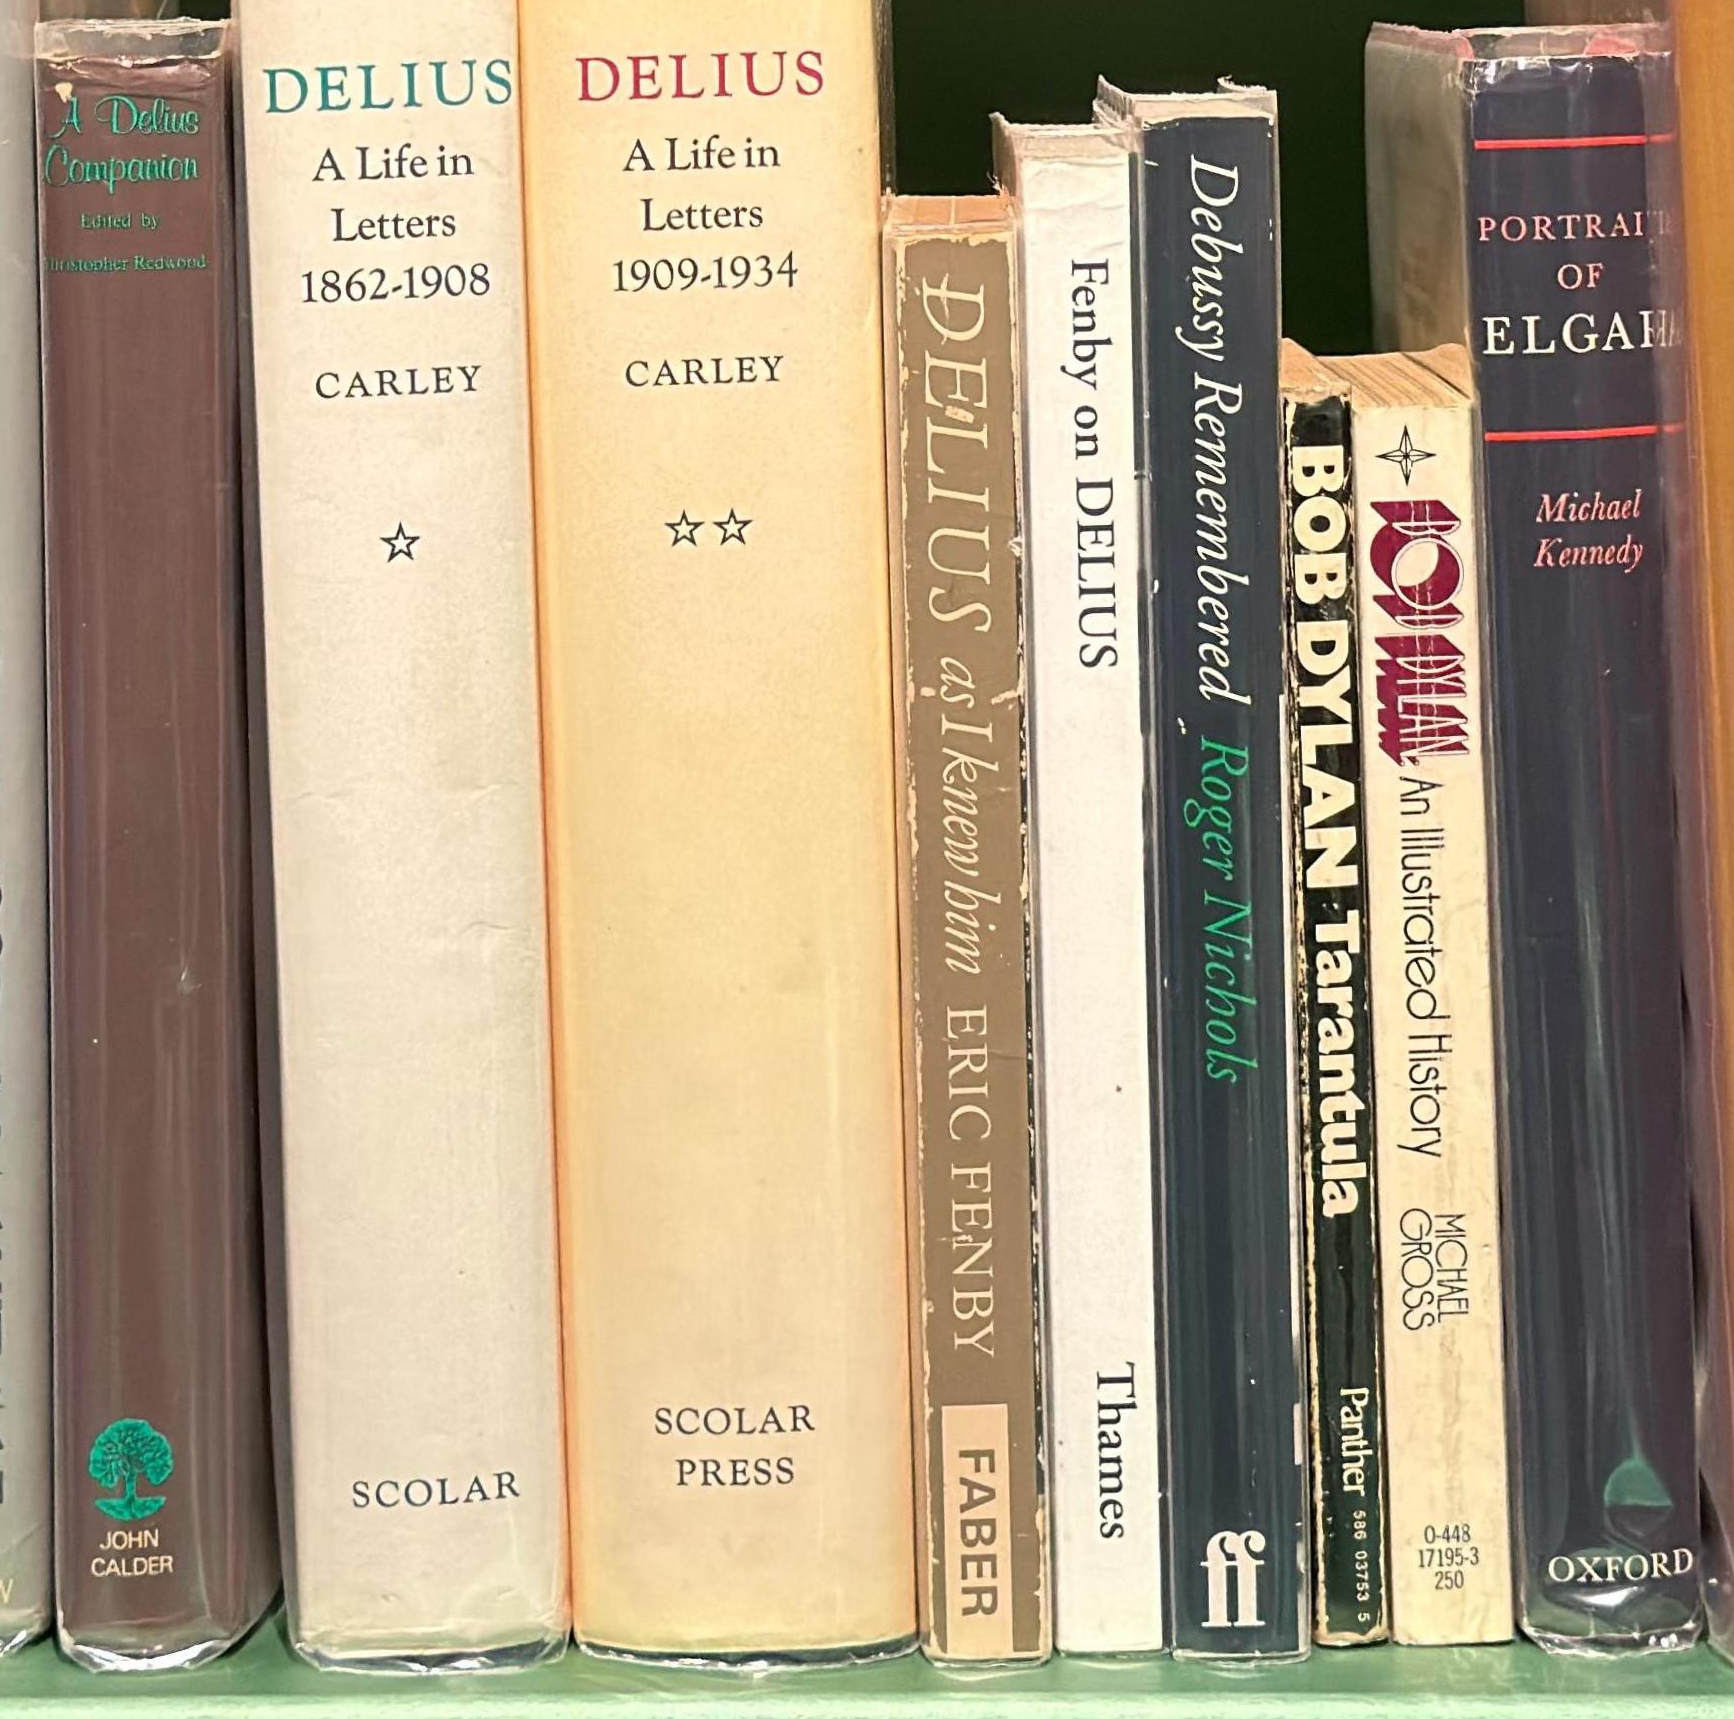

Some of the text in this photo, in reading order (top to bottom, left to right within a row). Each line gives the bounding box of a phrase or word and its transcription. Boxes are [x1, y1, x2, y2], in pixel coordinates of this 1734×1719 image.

[265, 58, 514, 114] DELIUS
[576, 50, 825, 103] DELIUS
[94, 95, 199, 134] Delius
[44, 144, 198, 193] Companion
[312, 143, 474, 183] A Life in
[622, 135, 781, 172] A Life in
[81, 213, 159, 229] Edited by
[331, 207, 456, 242] Letters
[640, 198, 763, 232] Letters
[134, 254, 207, 270] Redwood
[612, 252, 798, 295] 1909-1934
[1558, 263, 1603, 290] OF
[300, 264, 491, 305] 1862-1908
[314, 364, 483, 400] CARLEY
[624, 355, 784, 388] CARLEY
[1061, 259, 1119, 669] Fenby on DELIUS
[1536, 489, 1642, 524] Michael
[1534, 534, 1643, 574] Kennedy
[1174, 153, 1259, 1084] Debussy Remembered Roger Nichols
[920, 279, 1002, 1358] DELIUS knew him ERIC FENBY
[1291, 445, 1367, 1217] BOB DYLAN Tarantula
[1398, 775, 1453, 1158] An Illustrated History
[1400, 1209, 1436, 1331] GROSS
[1436, 1213, 1469, 1322] MICHAEL
[653, 1404, 816, 1437] SCOLAR
[1095, 1362, 1137, 1539] Thames
[351, 1470, 520, 1510] SCOLAR
[676, 1457, 795, 1488] PRESS
[1340, 1387, 1372, 1601] Panther 586 03753
[100, 1529, 159, 1550] JOHN
[958, 1448, 997, 1618] FABER
[91, 1555, 173, 1577] CALDER
[1419, 1548, 1479, 1568] 17195-3
[1548, 1547, 1694, 1582] OXFORD
[1435, 1570, 1464, 1590] 250
